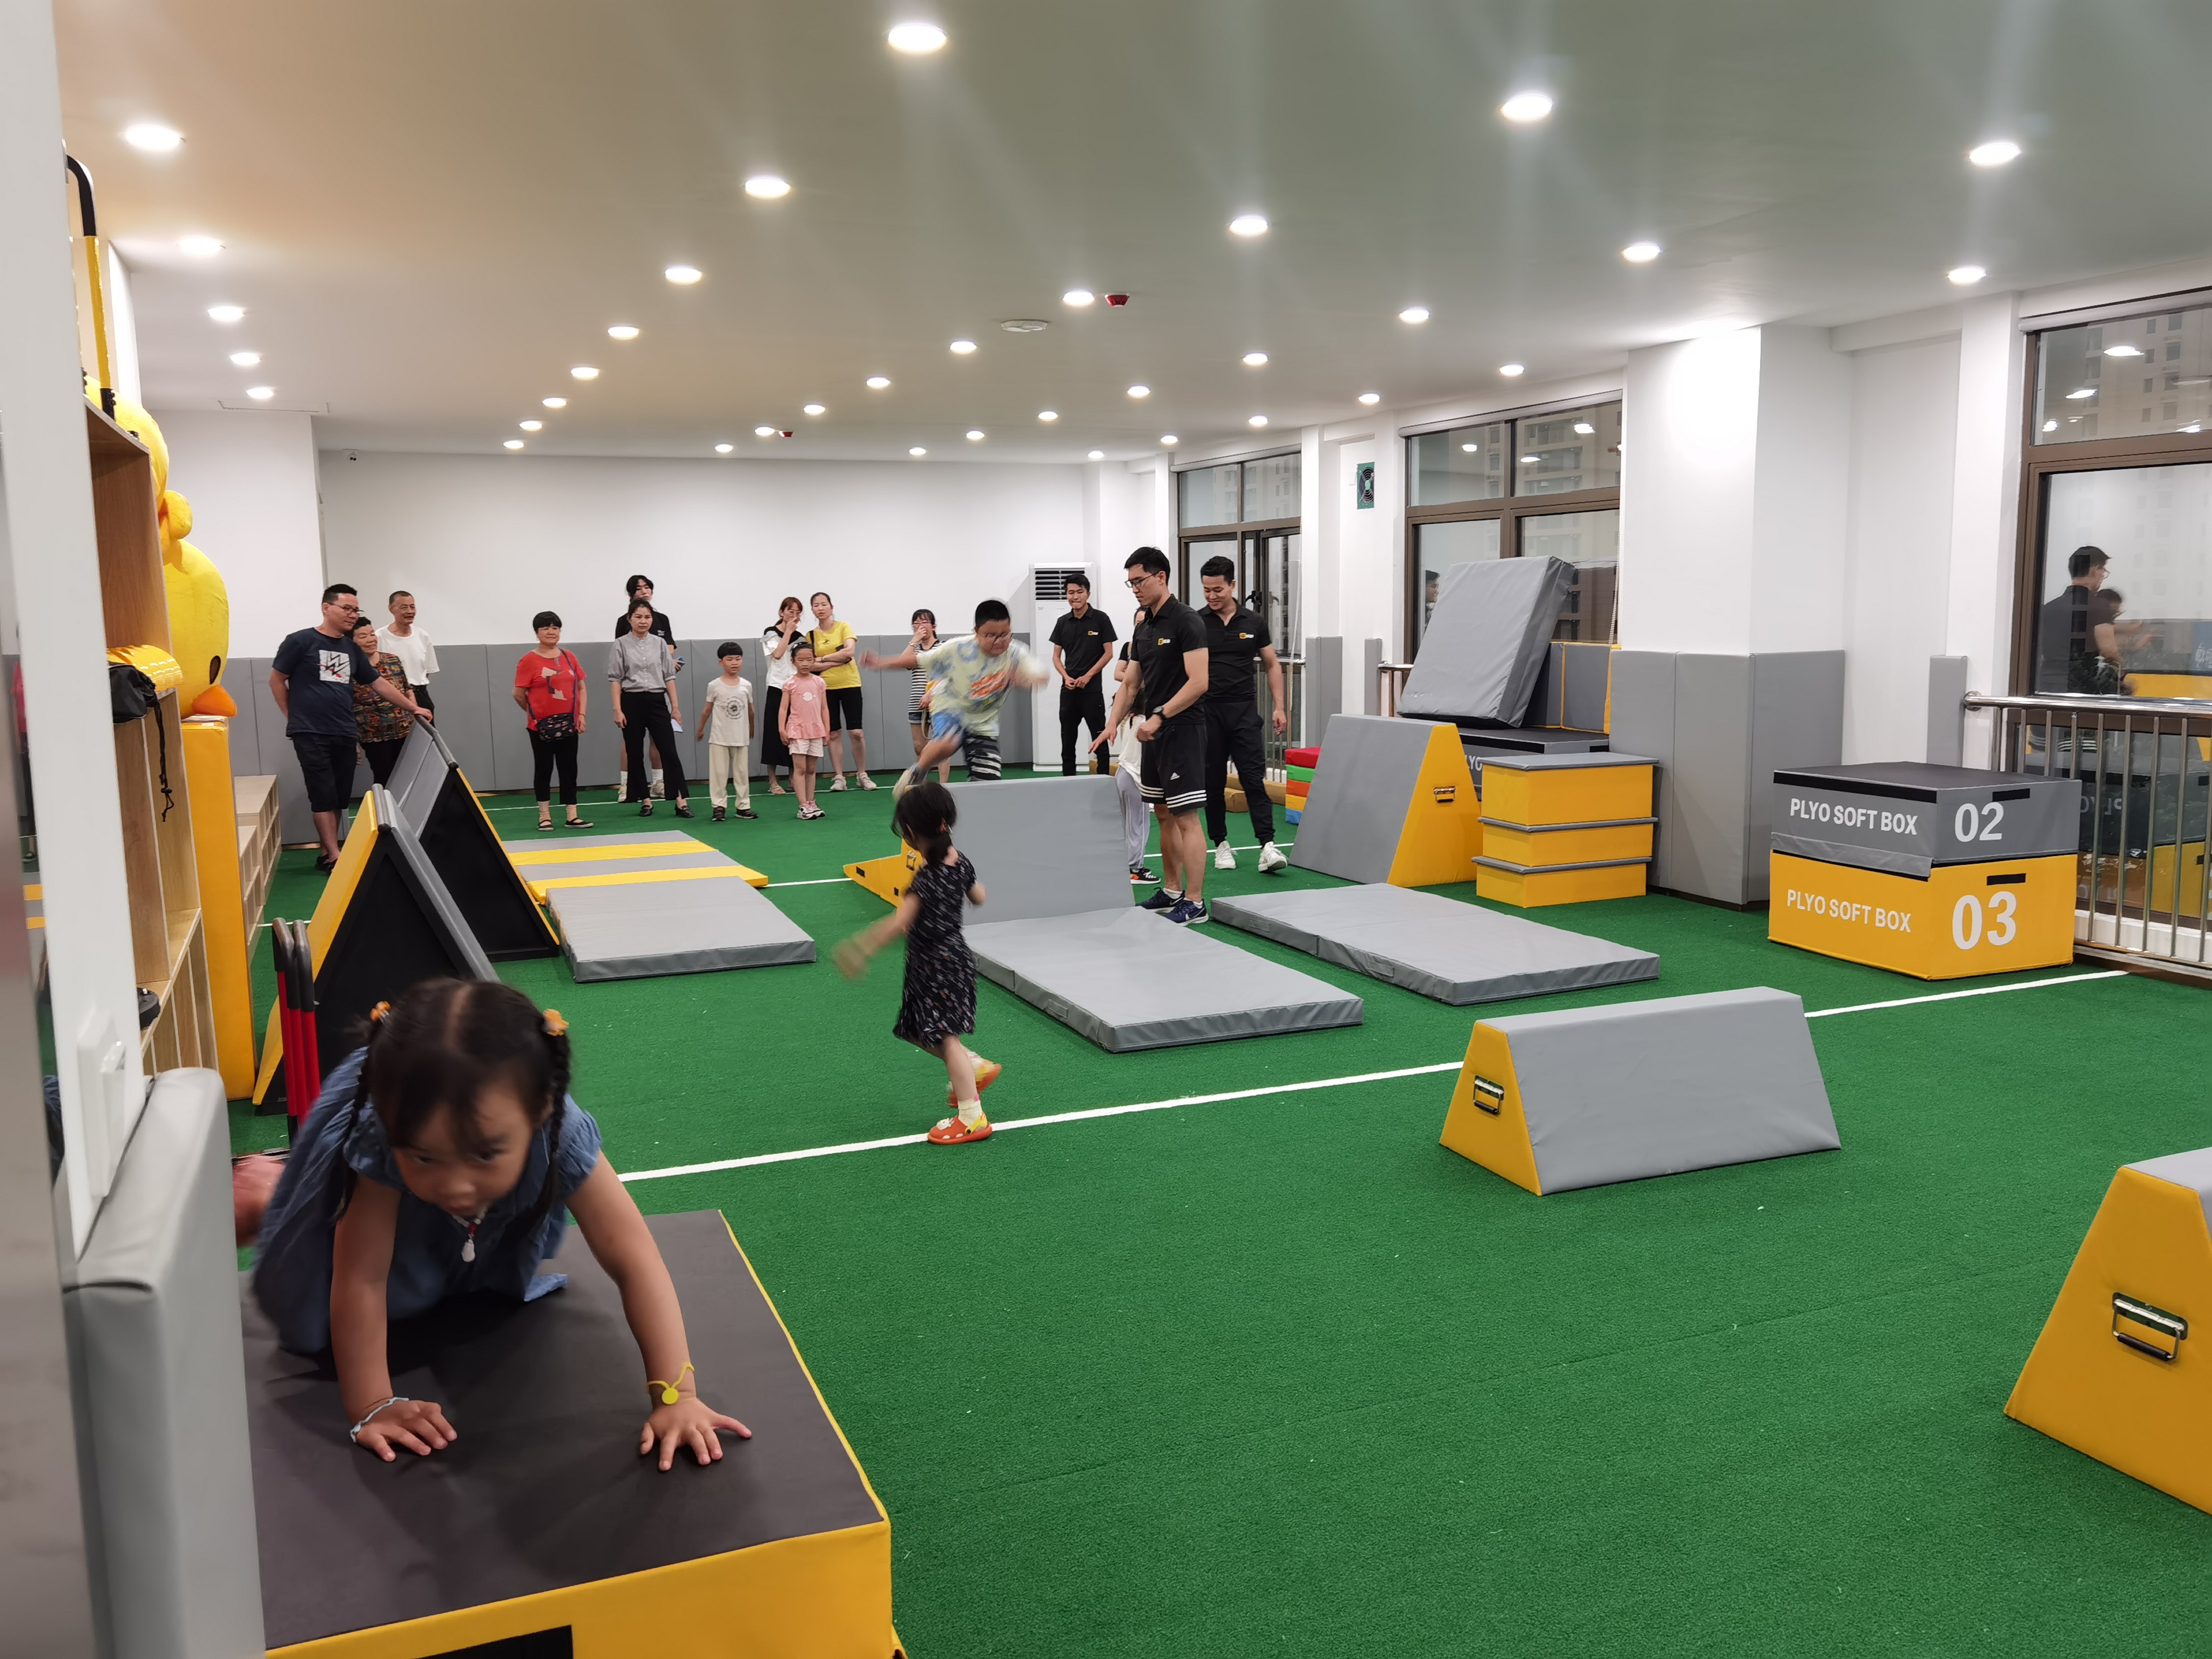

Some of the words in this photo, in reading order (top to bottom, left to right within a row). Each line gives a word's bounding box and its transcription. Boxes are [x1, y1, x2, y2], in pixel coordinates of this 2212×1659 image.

[1790, 798, 1831, 822] PLYO
[1833, 805, 1878, 830] SOFT
[1880, 811, 1918, 835] BOX
[1954, 802, 2004, 842] 02
[1787, 889, 1826, 914] PLYO
[1829, 899, 1872, 925] SOFT
[1875, 908, 1911, 933] BOX
[1952, 891, 2017, 950] 03
